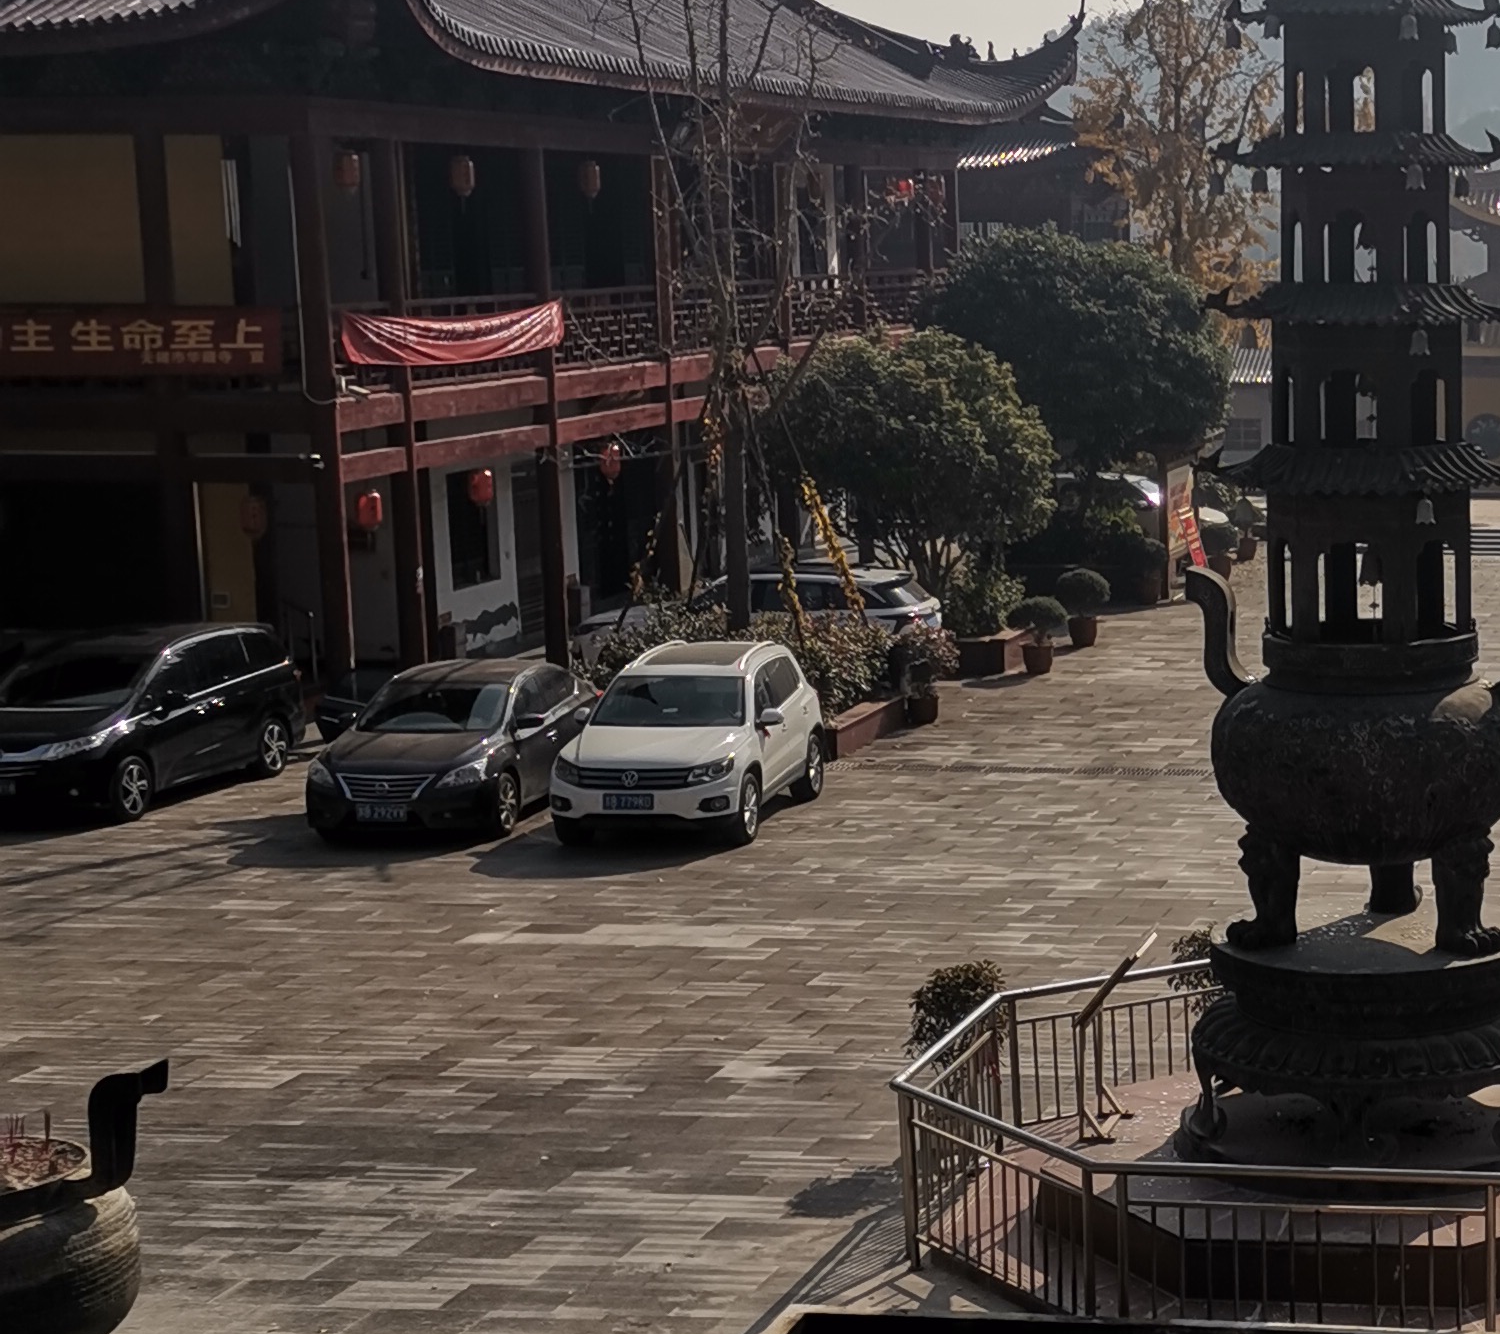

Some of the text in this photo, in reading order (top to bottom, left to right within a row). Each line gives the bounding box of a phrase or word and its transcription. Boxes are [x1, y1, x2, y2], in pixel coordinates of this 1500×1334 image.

[0, 318, 264, 353] 主 生命至上
